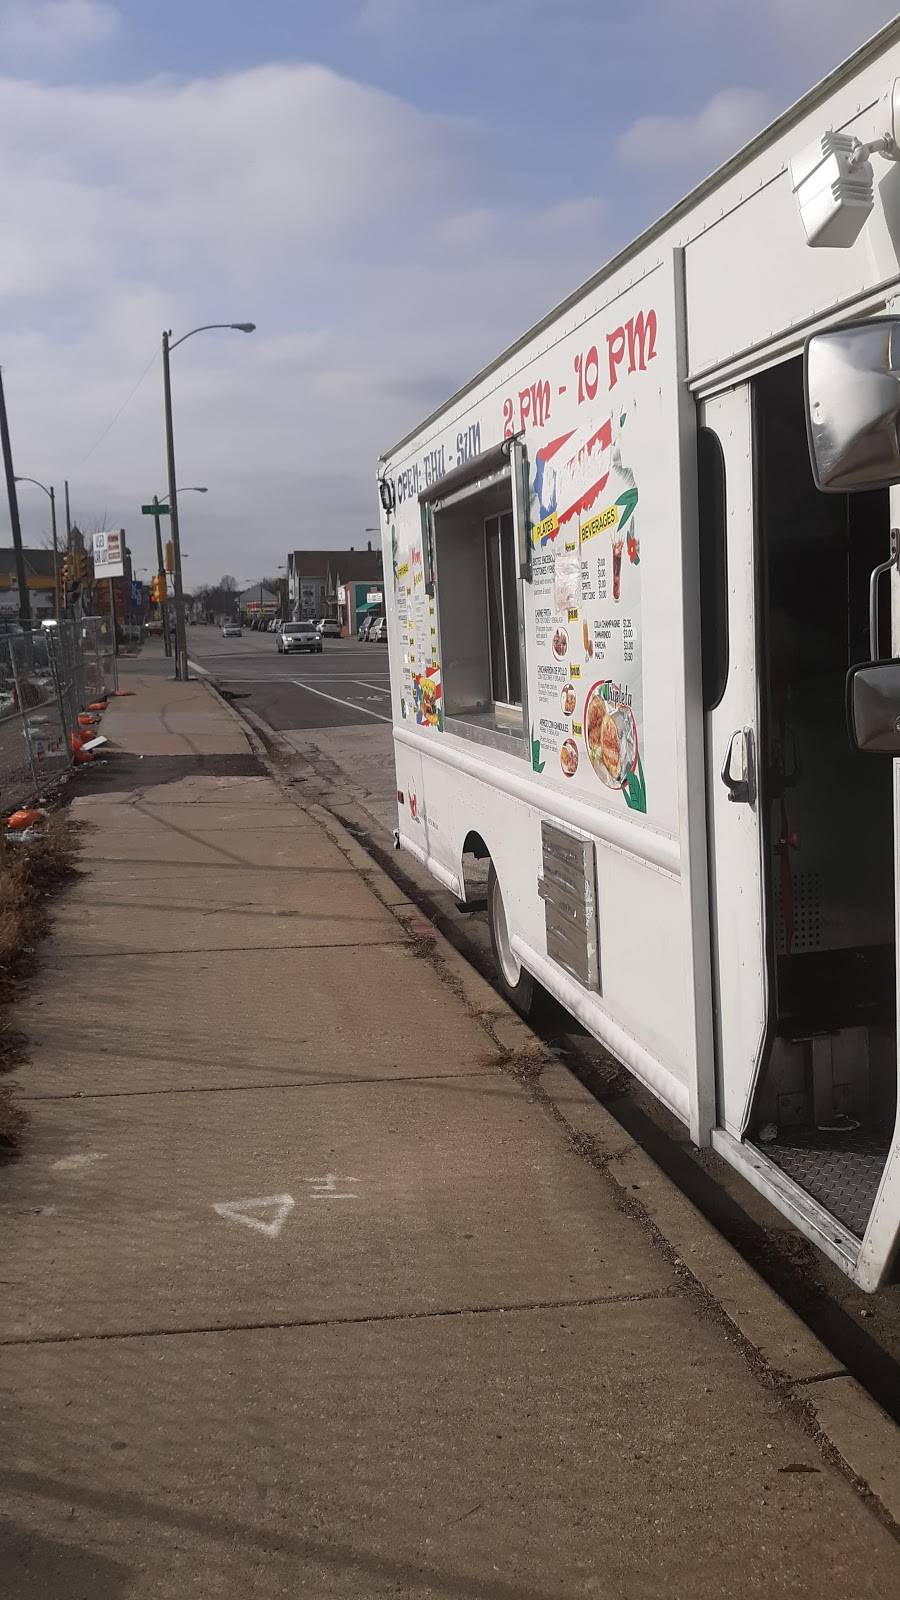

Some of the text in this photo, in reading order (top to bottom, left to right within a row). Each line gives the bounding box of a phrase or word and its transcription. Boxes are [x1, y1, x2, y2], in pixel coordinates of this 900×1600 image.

[424, 445, 446, 488] THU
[457, 421, 480, 466] SUN
[503, 398, 514, 438] 2
[519, 379, 550, 431] PM
[574, 346, 599, 406] 10
[606, 309, 657, 392] PM
[537, 518, 554, 536] PLATES
[581, 508, 616, 541] BEVERAGES
